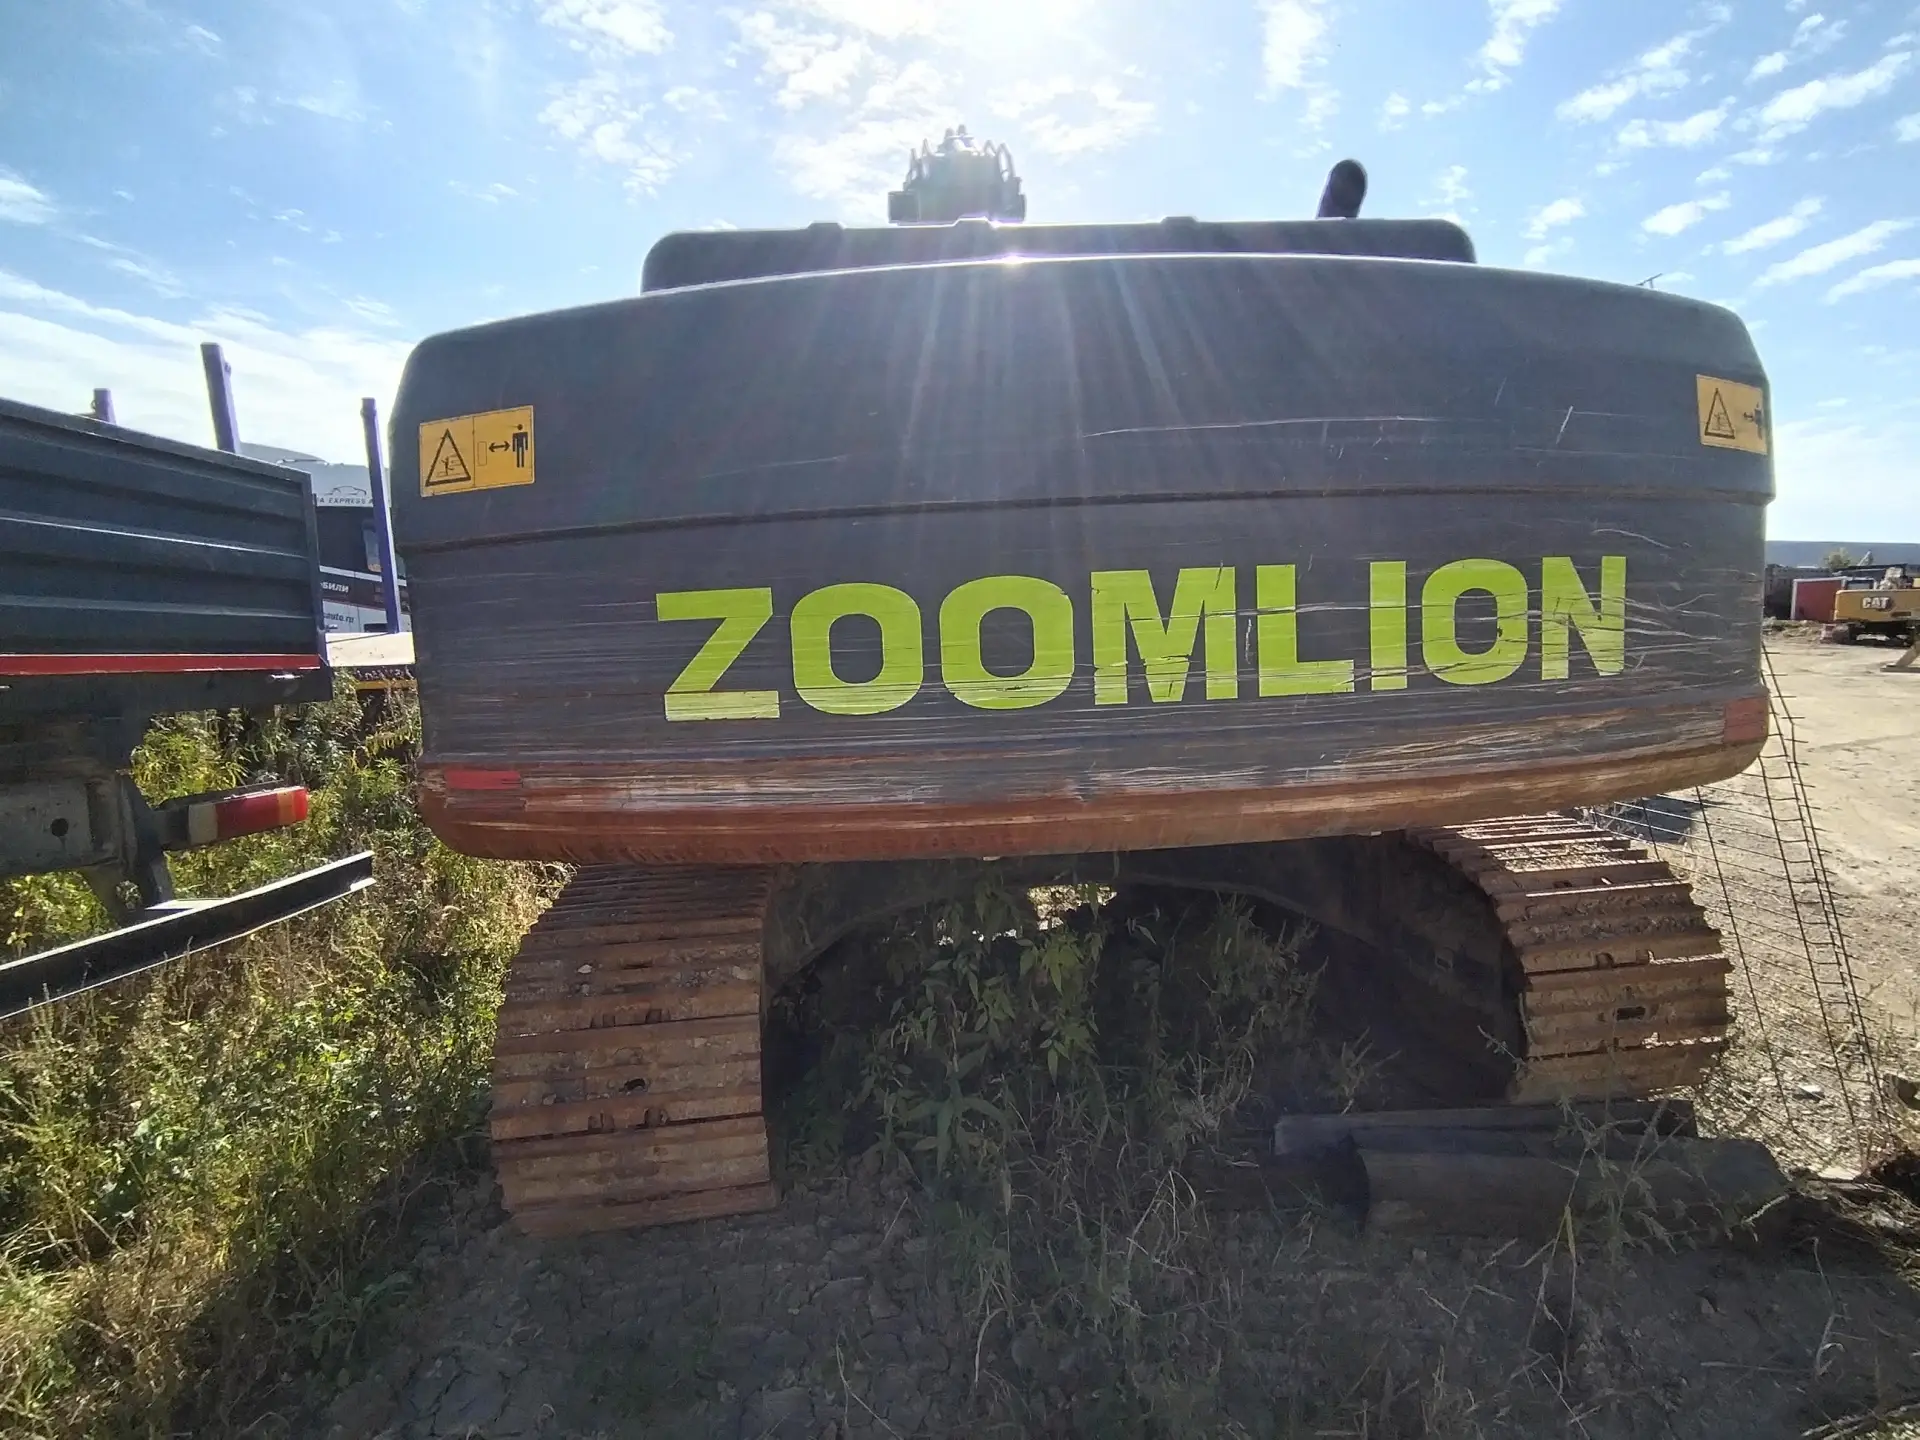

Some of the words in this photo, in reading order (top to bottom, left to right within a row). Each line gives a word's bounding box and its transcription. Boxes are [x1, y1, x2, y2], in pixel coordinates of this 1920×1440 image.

[320, 581, 349, 593] БИЛИ
[1862, 597, 1890, 609] CAT
[323, 613, 355, 624] auto.ru
[656, 555, 1627, 722] ZOOMLION
